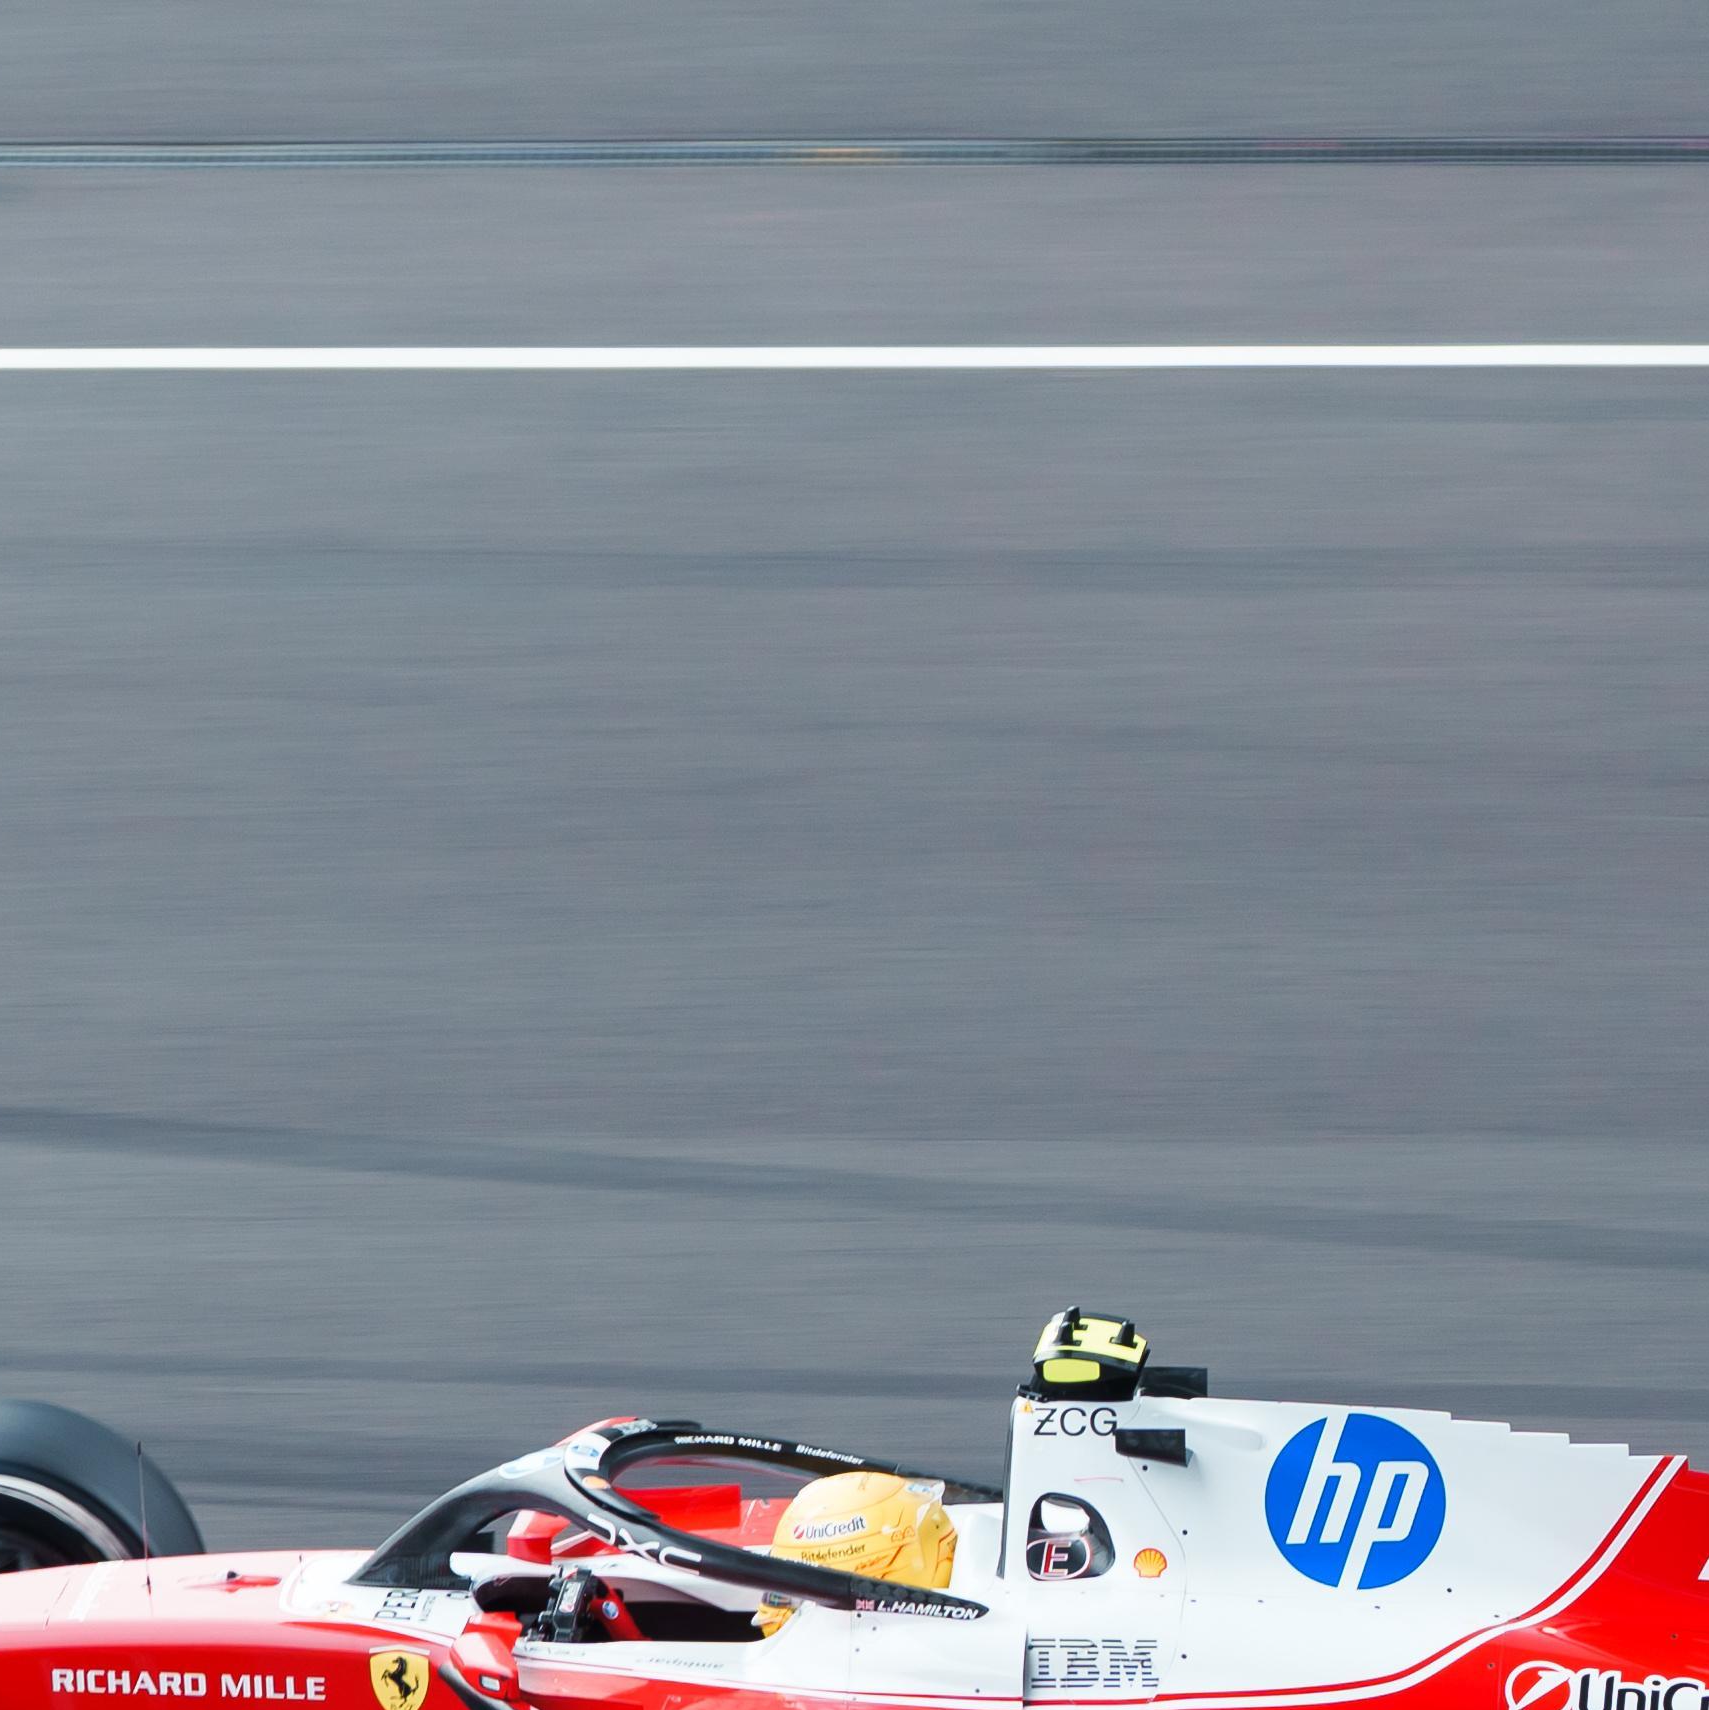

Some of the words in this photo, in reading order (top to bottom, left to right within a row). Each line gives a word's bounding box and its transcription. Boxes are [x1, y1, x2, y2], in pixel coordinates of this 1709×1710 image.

[1033, 1407, 1118, 1437] ZCG
[738, 1437, 783, 1453] MILLE
[796, 1444, 866, 1466] Bitdefender
[1285, 1413, 1431, 1590] hp
[805, 1516, 867, 1540] UniCredit
[1043, 1541, 1072, 1577] E
[876, 1599, 980, 1620] L.HAMILTON
[1028, 1638, 1160, 1689] IBM
[51, 1668, 207, 1698] RICHARD
[221, 1673, 327, 1701] MILLE
